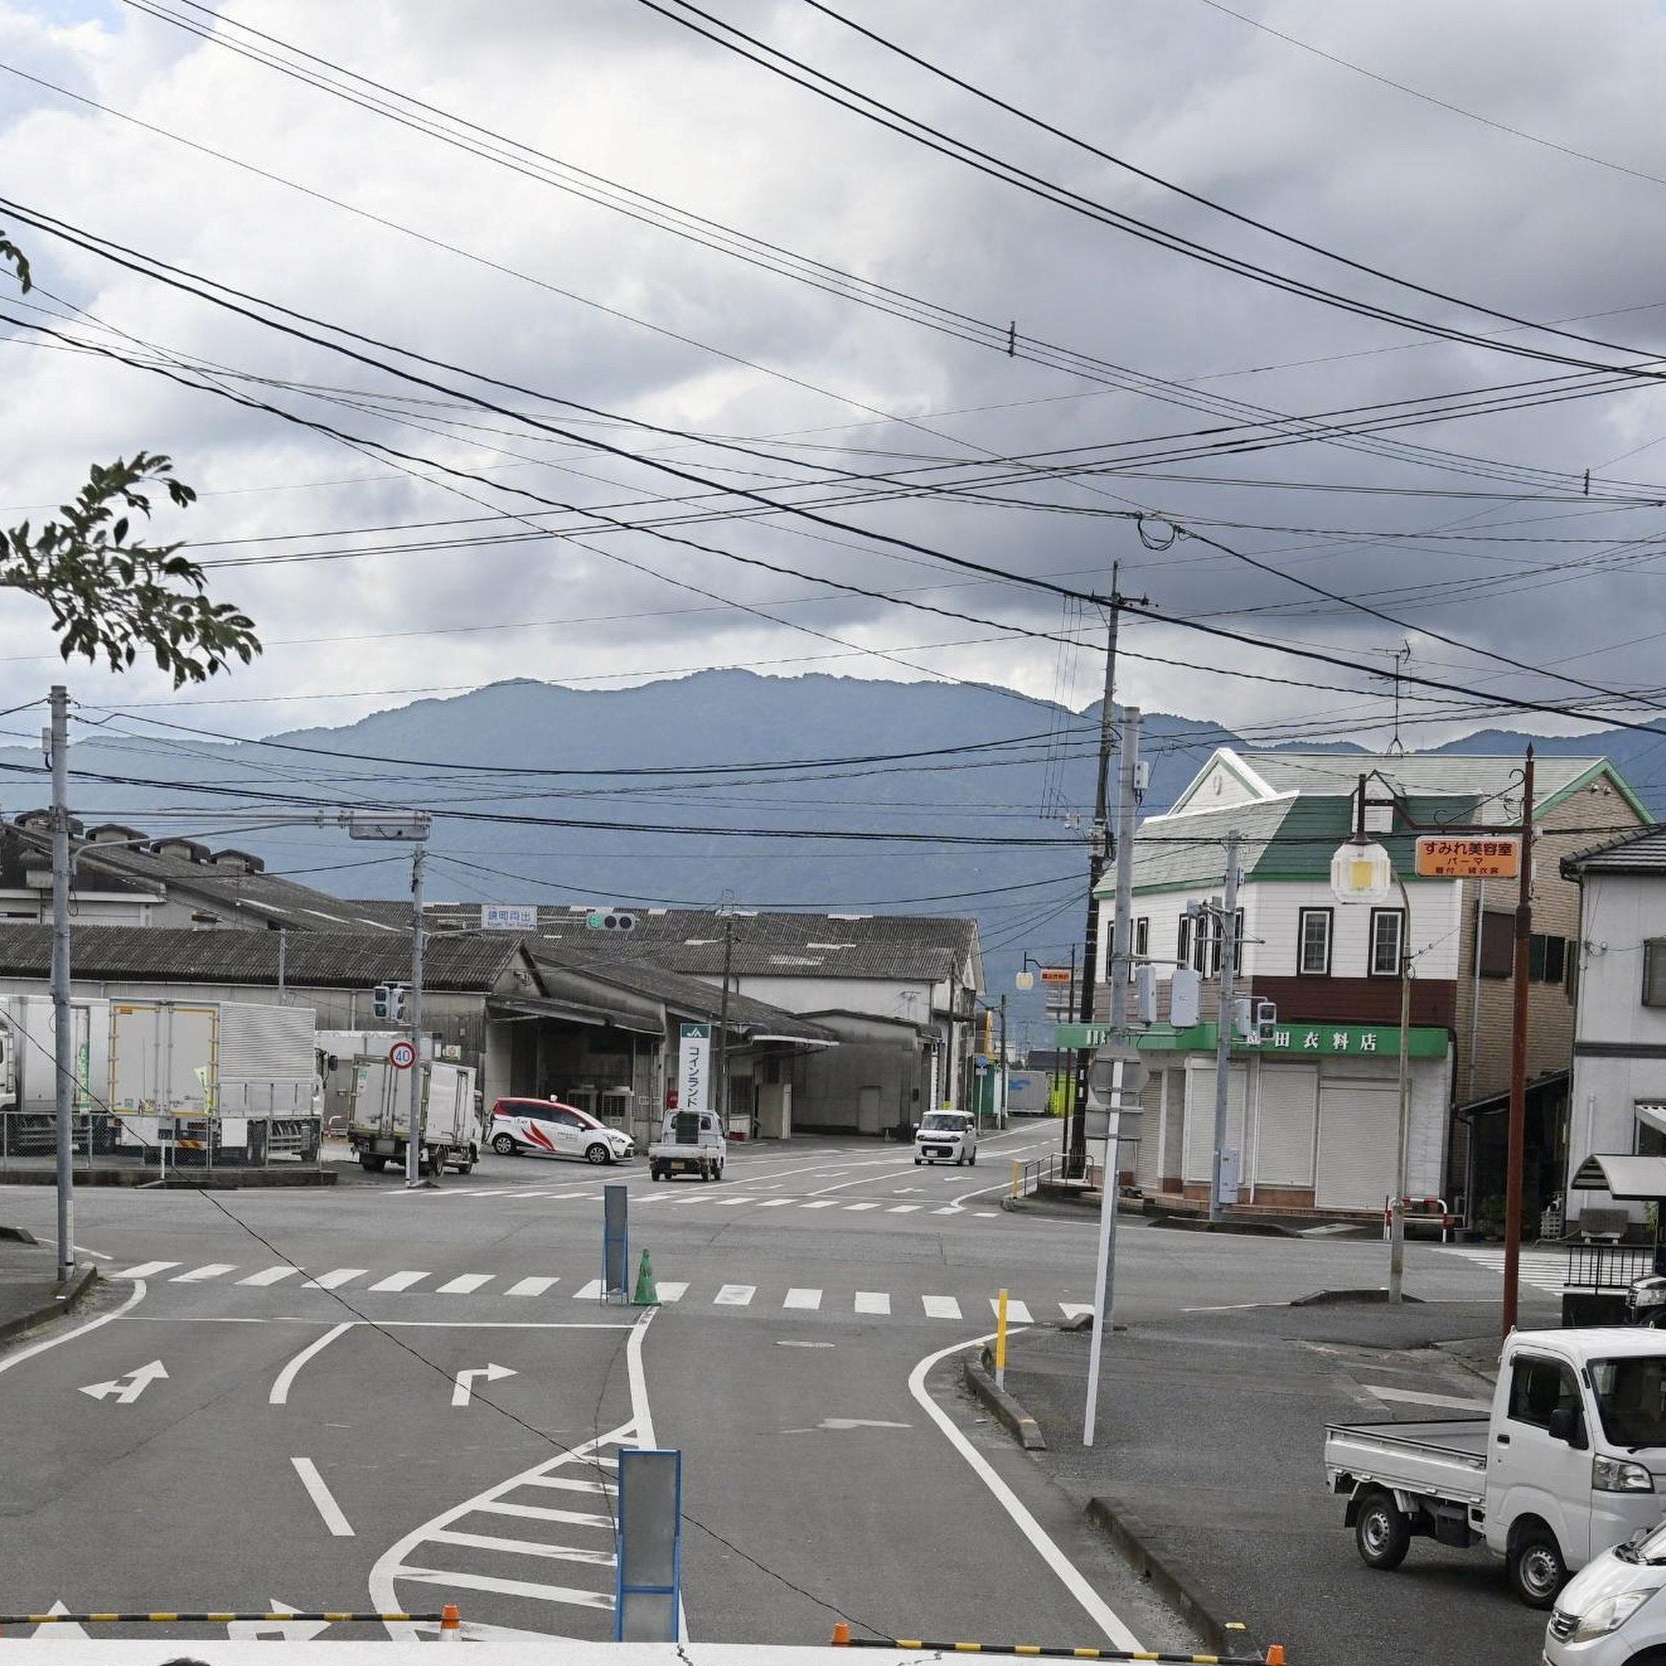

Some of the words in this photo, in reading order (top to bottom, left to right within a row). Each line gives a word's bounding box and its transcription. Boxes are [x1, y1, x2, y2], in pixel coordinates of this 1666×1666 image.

[1423, 841, 1513, 856] すみれ美容室
[1447, 857, 1484, 865] パーマ
[394, 1050, 410, 1062] 40
